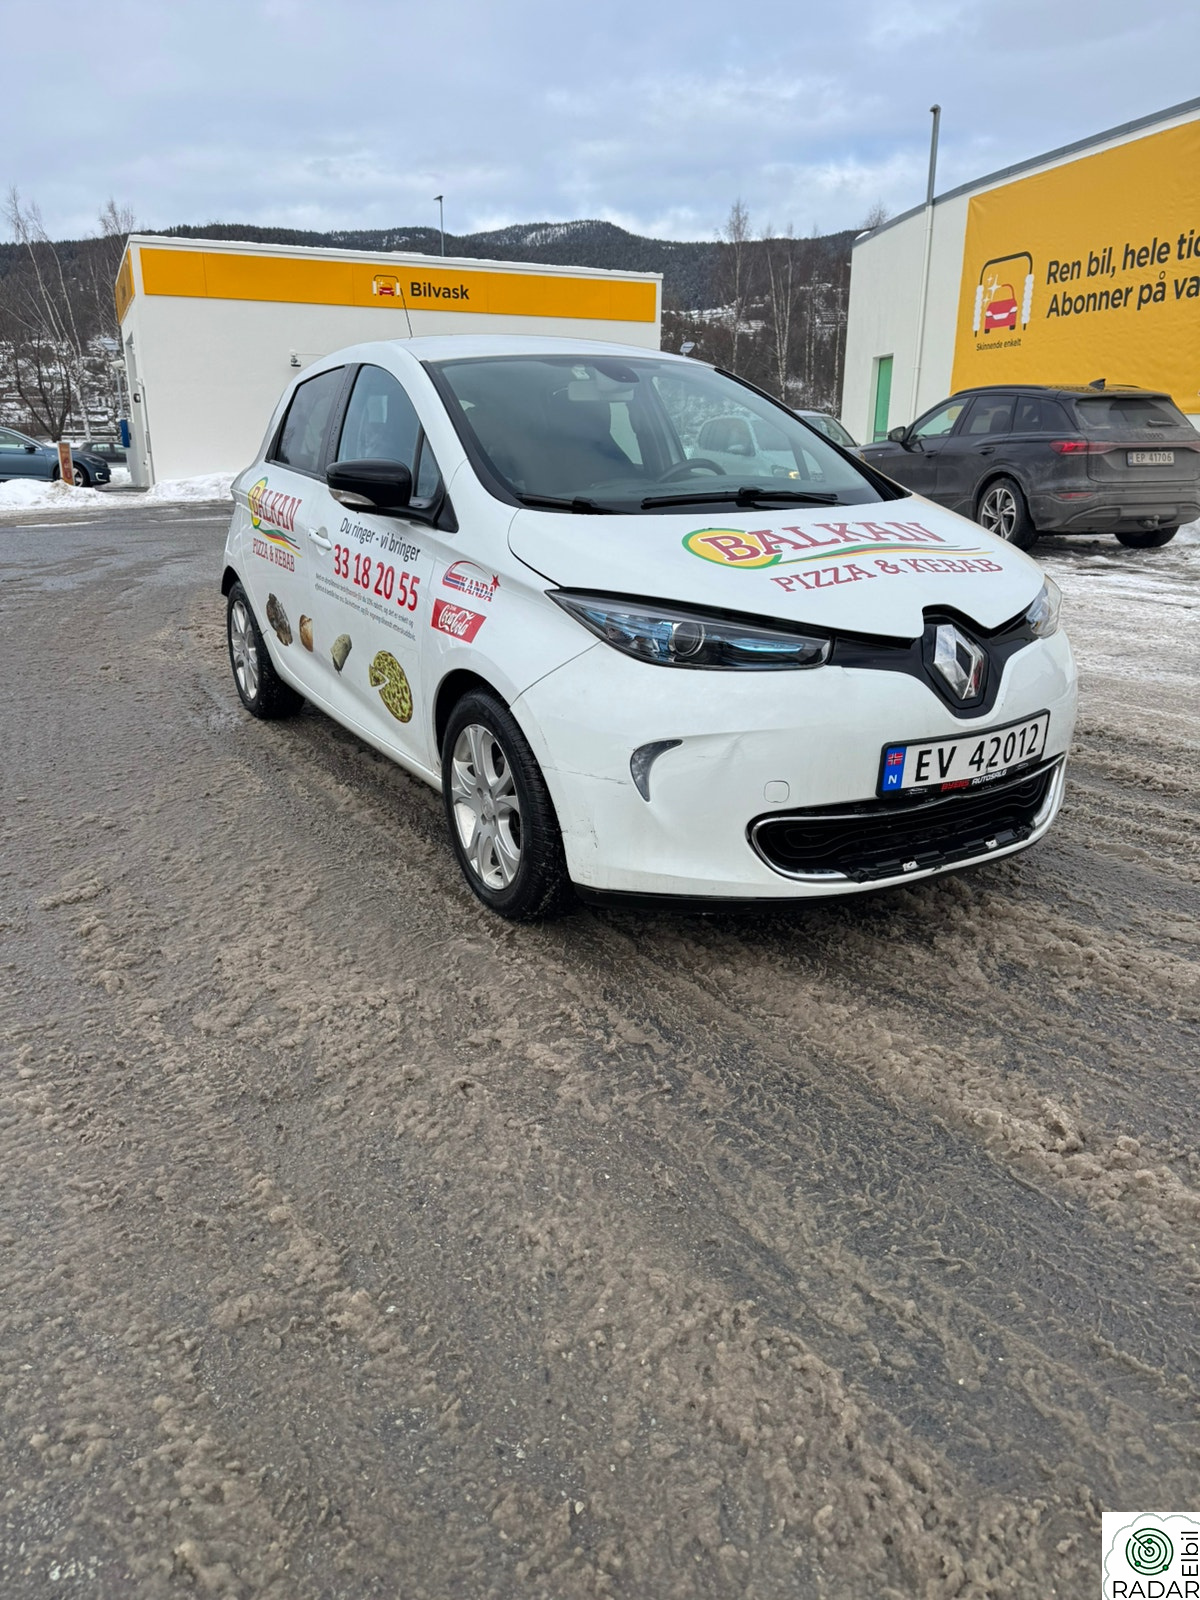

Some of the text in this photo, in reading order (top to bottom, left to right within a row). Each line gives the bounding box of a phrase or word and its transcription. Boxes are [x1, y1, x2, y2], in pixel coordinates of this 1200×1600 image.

[1046, 260, 1081, 285] Ren
[1086, 246, 1116, 278] bil,
[1122, 237, 1170, 271] hele
[410, 281, 470, 300] Bilvask
[1046, 285, 1133, 319] Abonner
[1136, 270, 1167, 312] på
[976, 338, 1022, 351] Skinnende enkelt
[1135, 453, 1172, 463] EP 41706
[251, 486, 302, 532] BALKAN
[252, 538, 295, 573] PIZZA & KEBAB
[340, 517, 352, 535] Du
[351, 521, 375, 545] ringer
[380, 532, 390, 550] vi
[388, 533, 421, 562] bringer
[701, 521, 946, 562] BALKAN
[334, 543, 350, 580] 33
[353, 552, 372, 590] 18
[373, 561, 395, 601] 20
[396, 571, 421, 612] 55
[770, 558, 1004, 593] PIZZA & KEBAB
[914, 723, 1039, 783] EV 42012
[888, 774, 898, 785] N
[971, 769, 1007, 785] AUTOSALG
